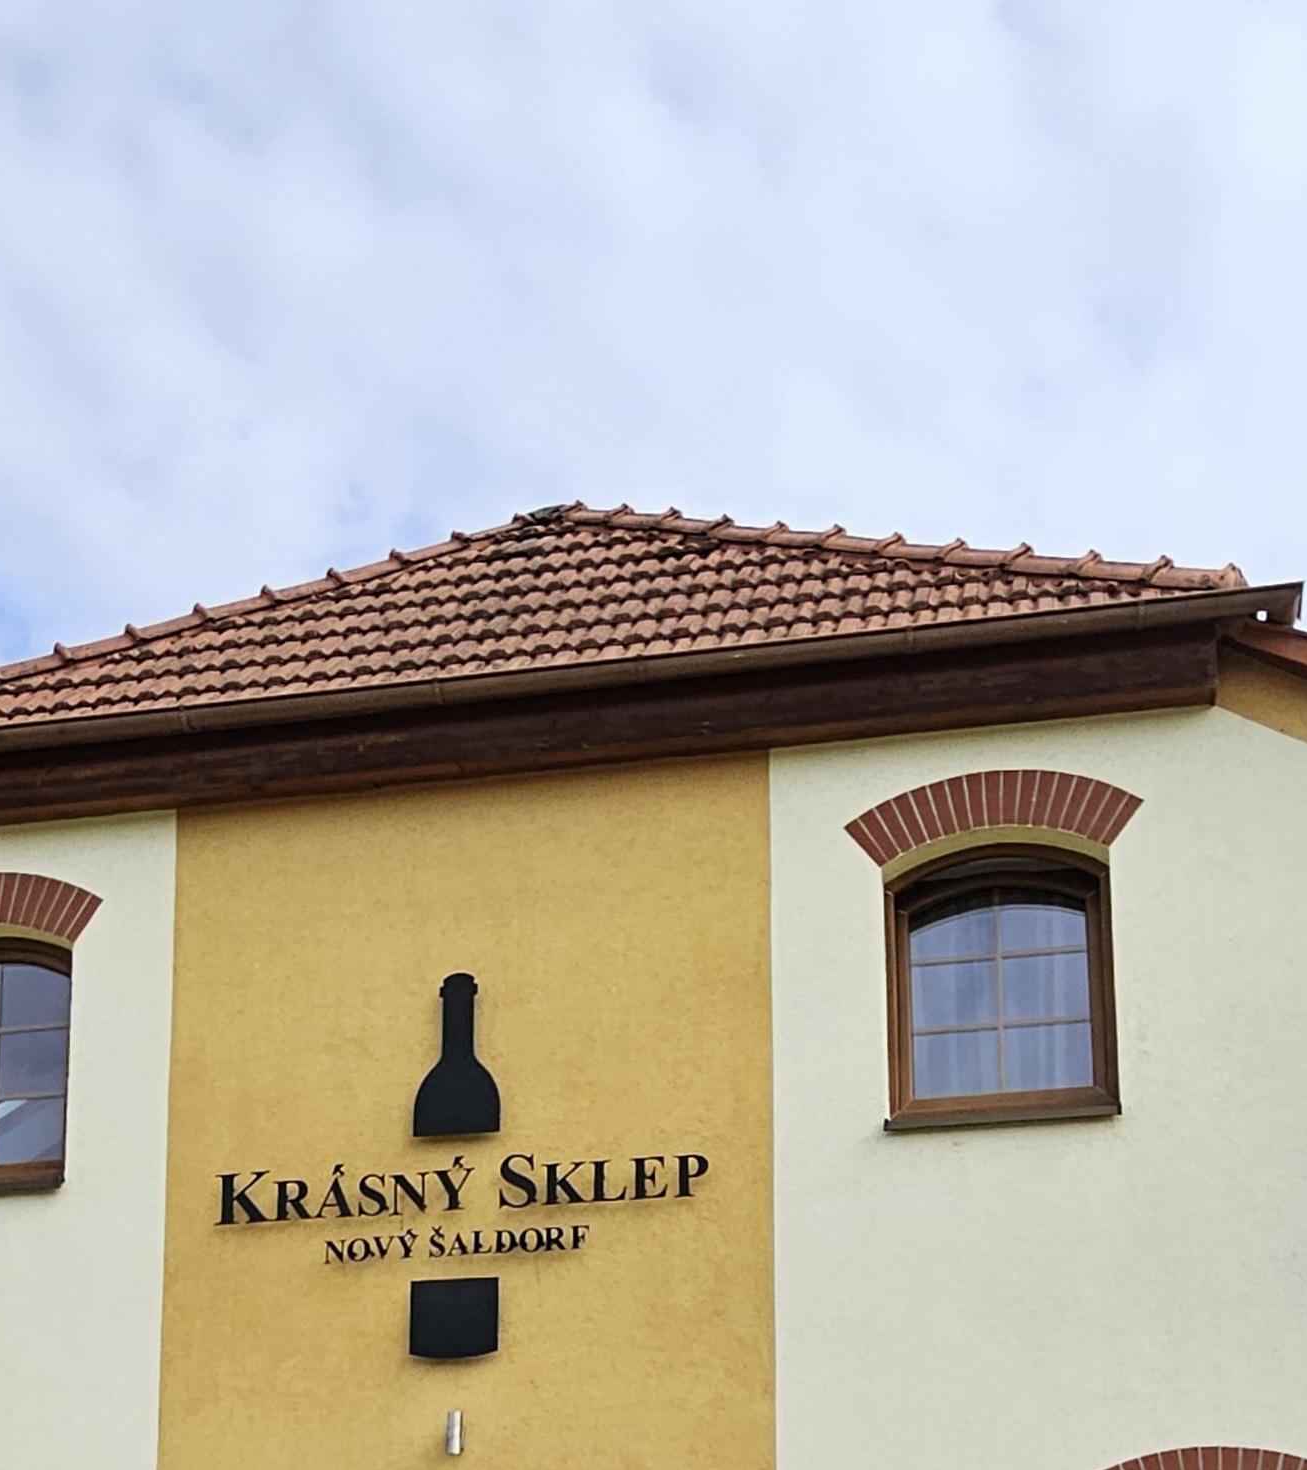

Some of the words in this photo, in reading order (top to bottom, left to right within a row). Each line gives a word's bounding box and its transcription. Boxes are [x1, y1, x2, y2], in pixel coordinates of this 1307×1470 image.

[214, 1156, 473, 1225] KRÁSNÝ
[498, 1153, 709, 1209] SKLEP
[324, 1229, 419, 1264] NOVÝ
[428, 1225, 590, 1258] ŠALDORF
